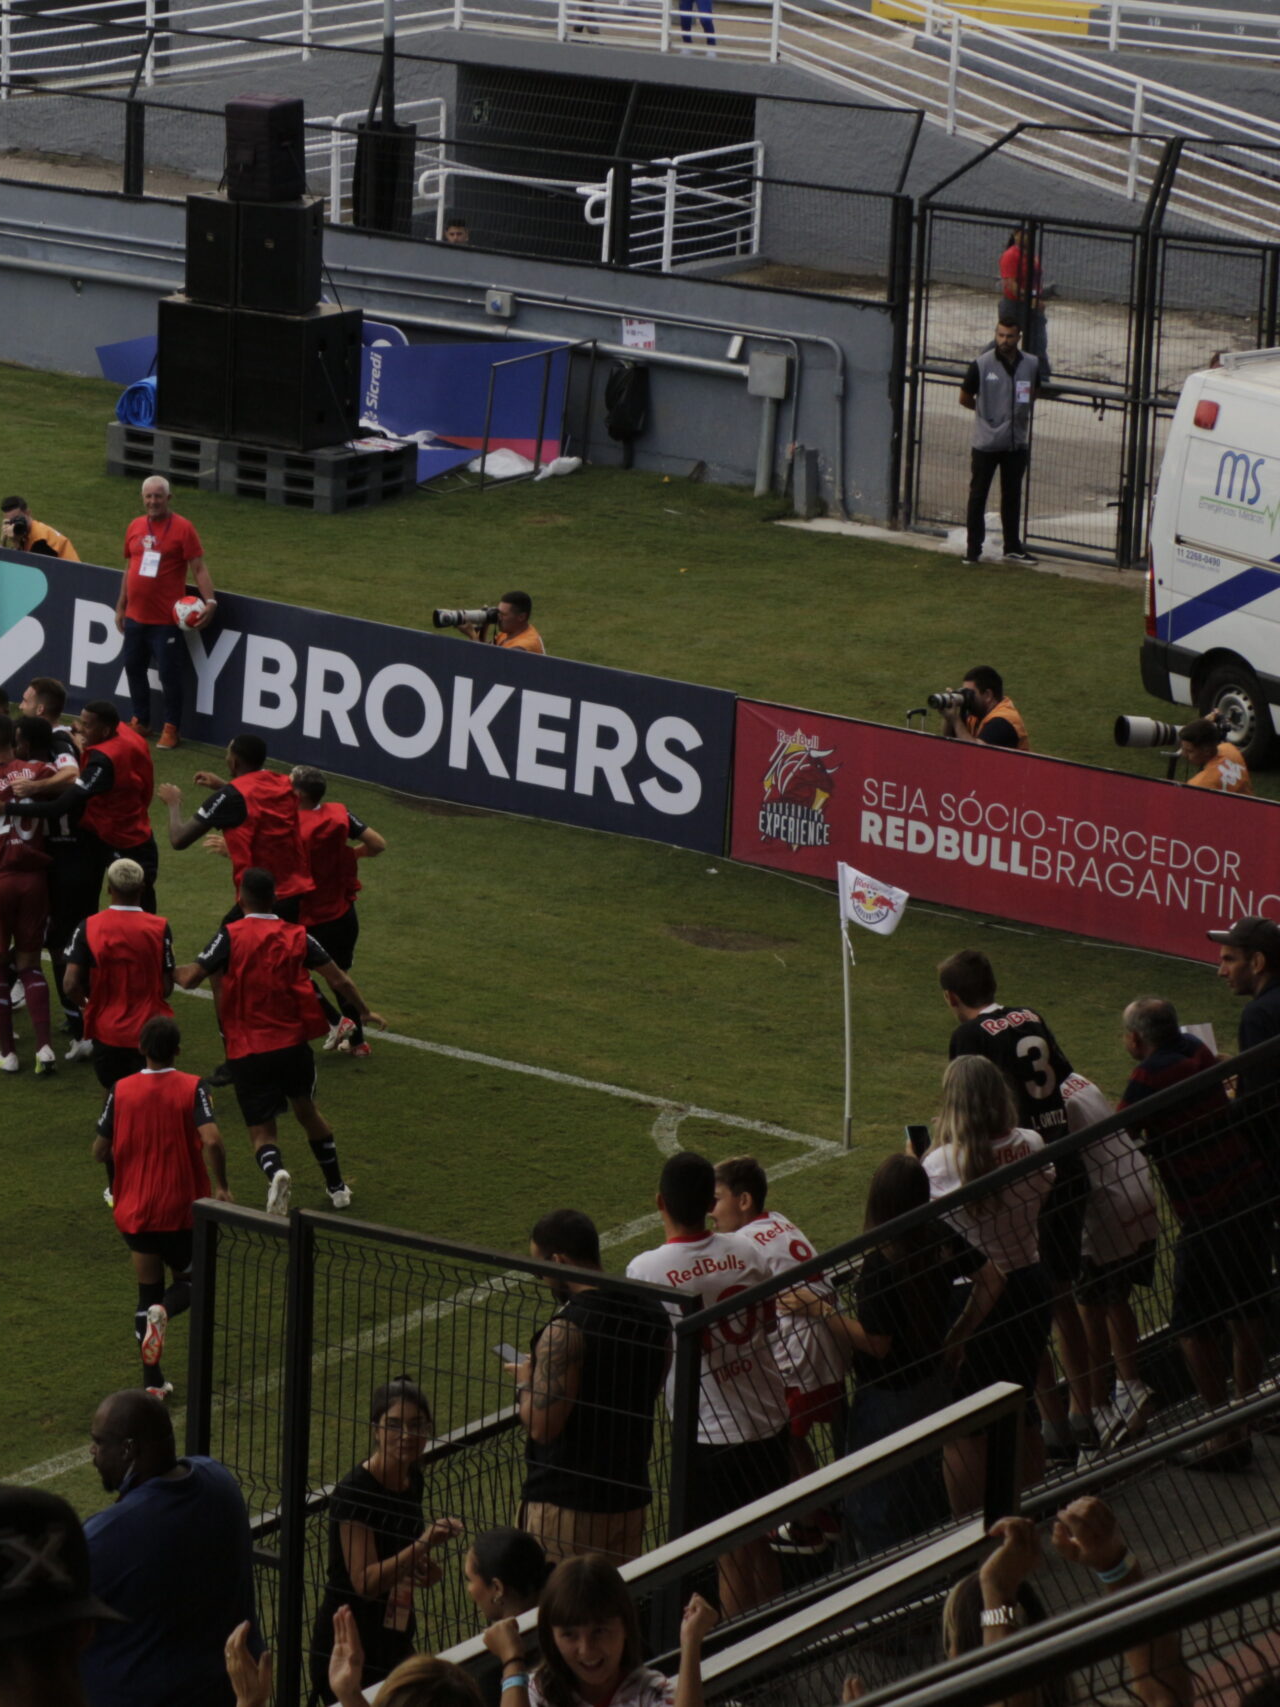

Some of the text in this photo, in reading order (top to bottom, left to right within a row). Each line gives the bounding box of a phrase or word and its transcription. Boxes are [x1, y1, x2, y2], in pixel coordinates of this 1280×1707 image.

[365, 351, 382, 410] Sicredi
[69, 597, 703, 816] PYBROKERS
[758, 810, 831, 847] EXPERIENCE
[862, 777, 1241, 882] SEJA SÓCIO-TORCEDOR
[1016, 1034, 1057, 1101] 3
[666, 1254, 746, 1288] RedBulls
